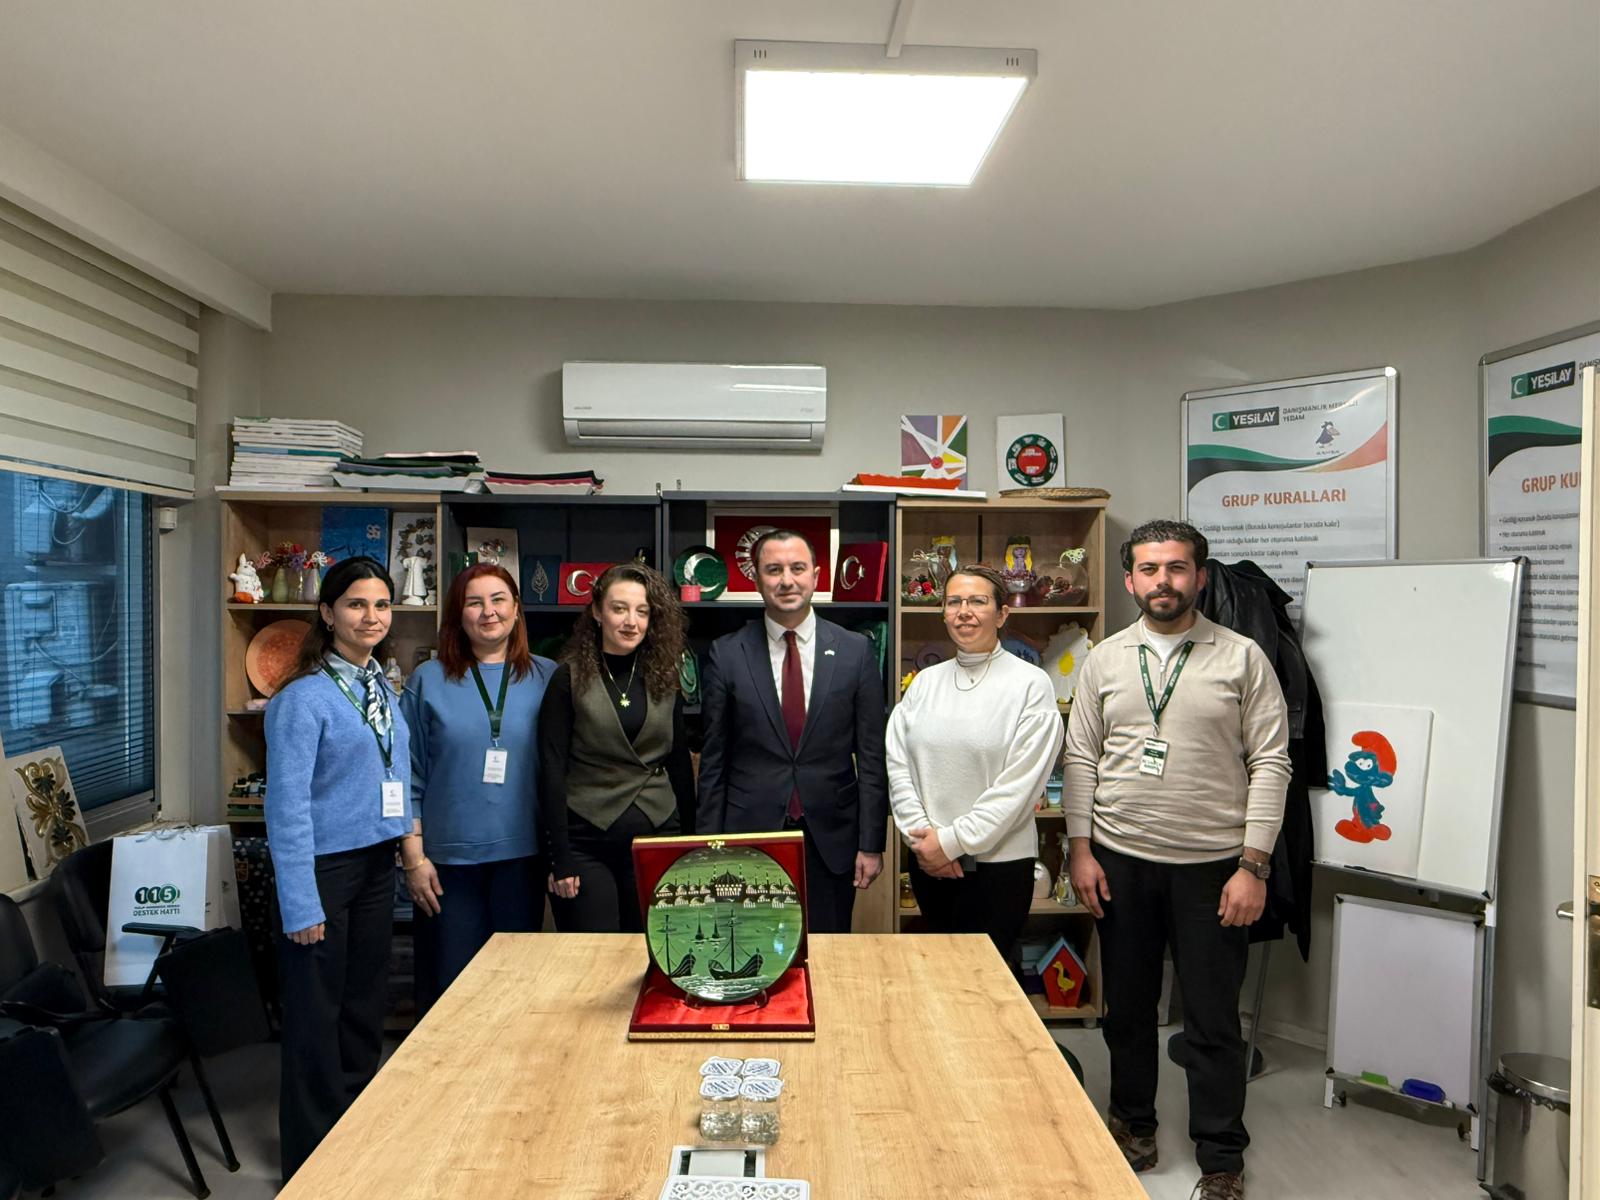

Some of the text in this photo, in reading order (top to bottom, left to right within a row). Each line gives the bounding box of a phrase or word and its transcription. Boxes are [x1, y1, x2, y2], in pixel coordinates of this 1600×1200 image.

[1282, 404, 1327, 414] DANIŞMANLIK
[1282, 414, 1305, 422] YEDAM
[1522, 472, 1581, 493] GRUP KU
[1222, 488, 1346, 508] GRUP KURALLARI
[133, 908, 180, 917] DESTEK HATTI
